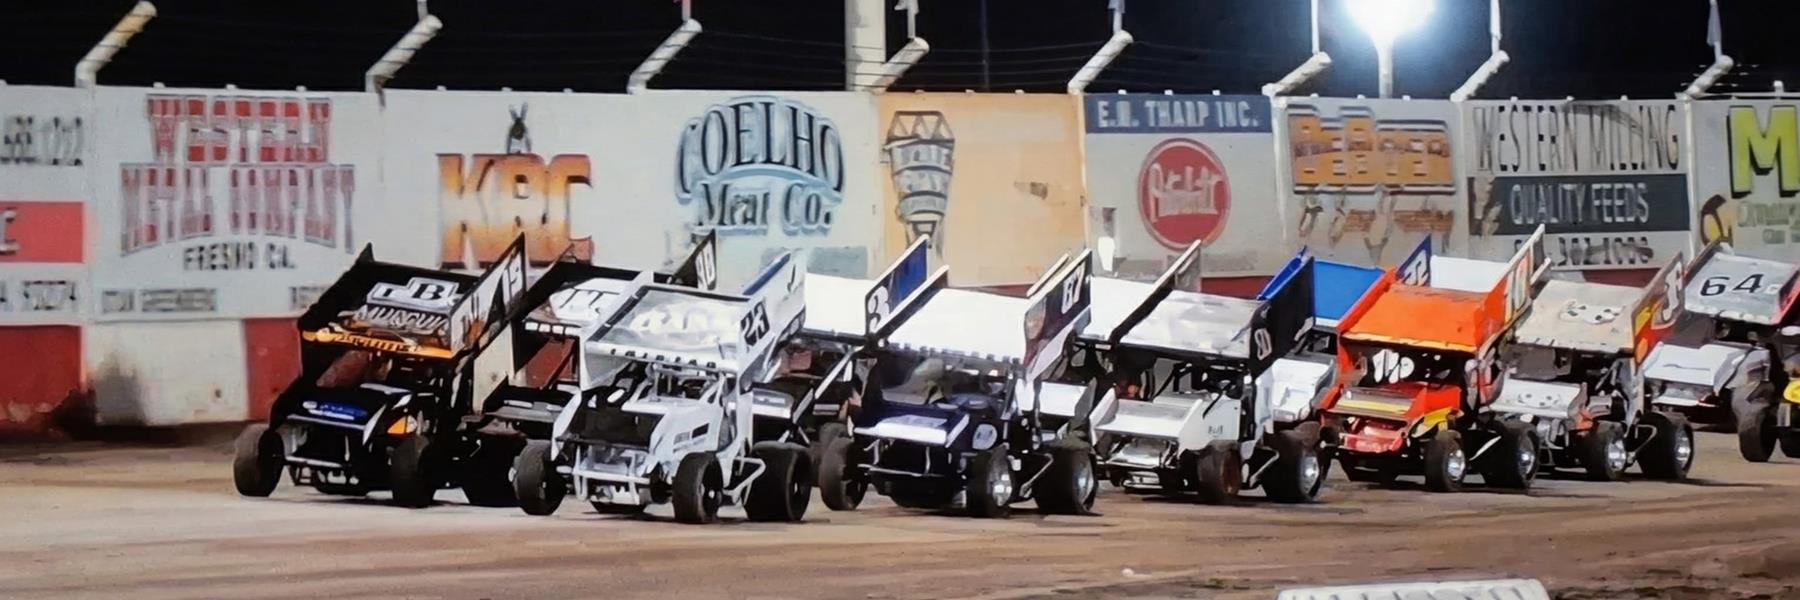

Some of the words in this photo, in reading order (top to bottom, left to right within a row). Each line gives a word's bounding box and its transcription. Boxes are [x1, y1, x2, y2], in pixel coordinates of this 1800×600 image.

[147, 93, 331, 163] WESTERN
[1215, 101, 1258, 127] INC.
[1472, 105, 1579, 171] WESTERN
[675, 98, 846, 206] COELHO
[120, 163, 216, 257] METAL
[228, 163, 355, 255] COMPANY
[697, 181, 769, 229] Meat
[782, 182, 832, 229] Co.
[1510, 183, 1585, 225] QUALITY
[1591, 183, 1649, 223] FEEDS
[183, 242, 256, 270] FRESNO
[1700, 273, 1765, 297] 64
[740, 299, 770, 348] 23
